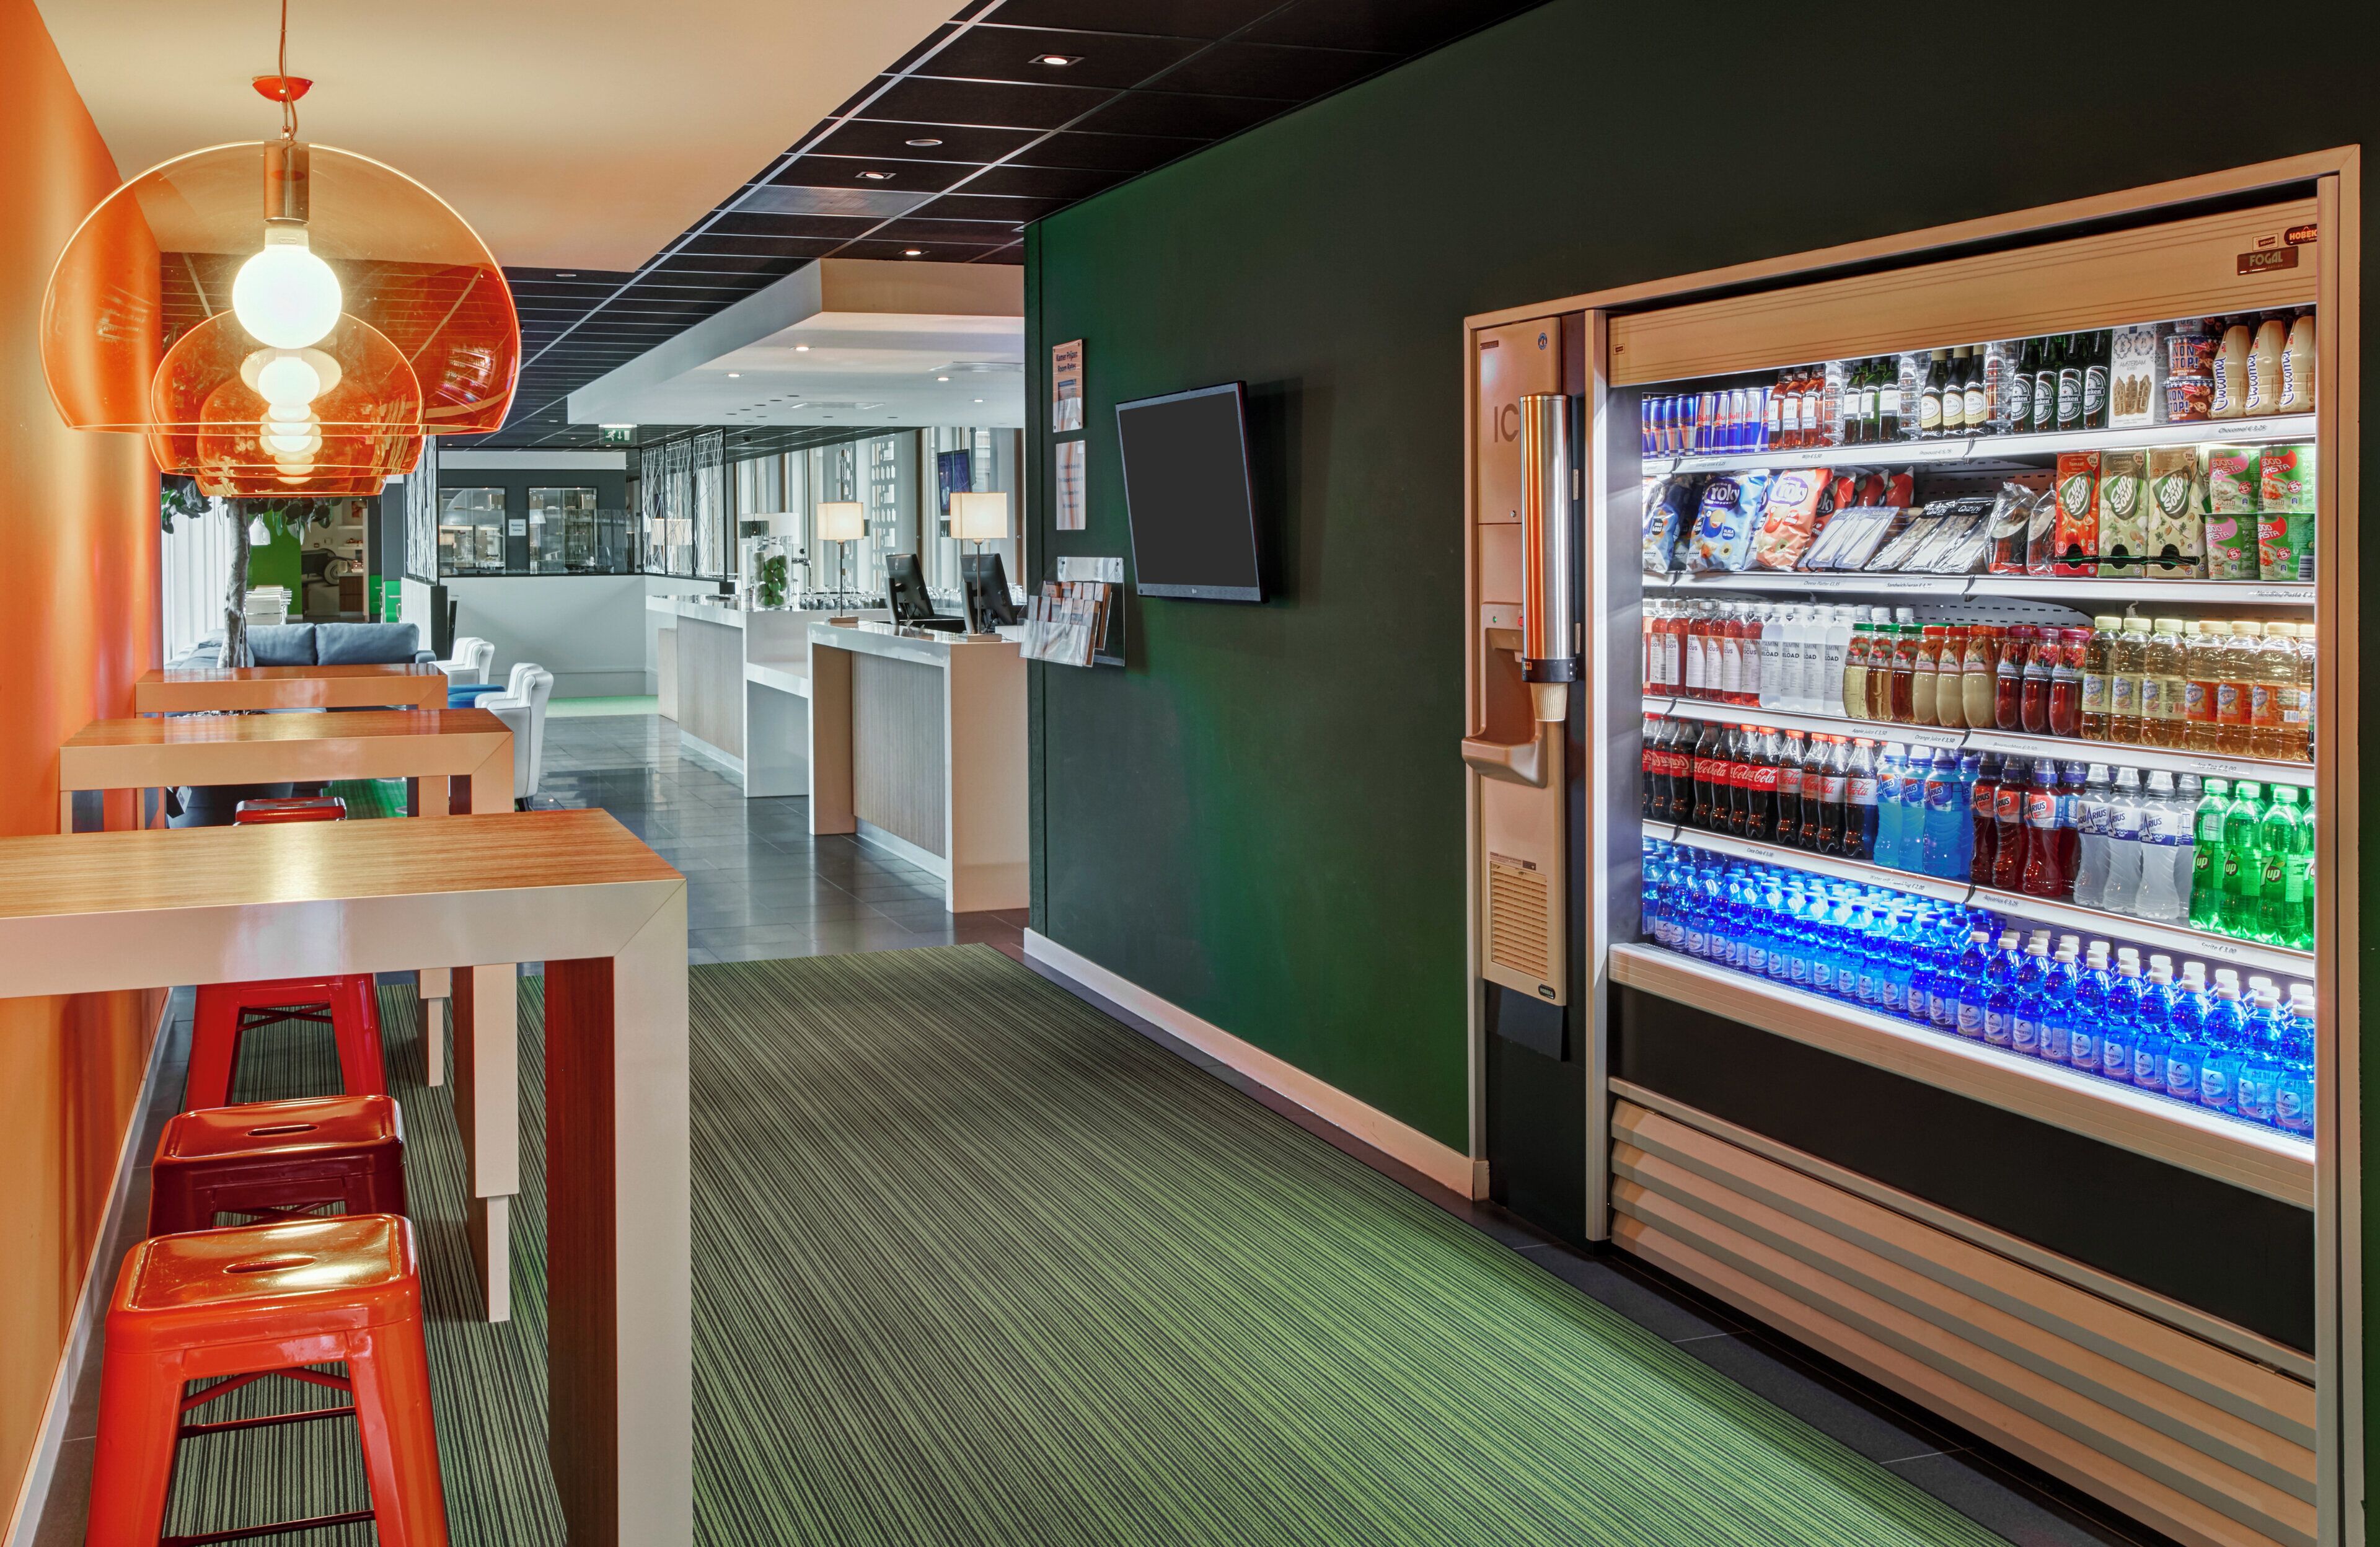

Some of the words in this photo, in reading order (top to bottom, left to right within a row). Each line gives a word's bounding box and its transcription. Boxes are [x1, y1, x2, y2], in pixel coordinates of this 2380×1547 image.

[2289, 229, 2317, 240] HOBEK
[2249, 251, 2283, 267] FOGAL
[2173, 345, 2195, 356] NON
[2172, 358, 2199, 369] STOP!
[2169, 401, 2189, 412] TOP!
[1716, 413, 1725, 421] Bu
[1494, 403, 1519, 443] IC
[2212, 464, 2242, 477] PASTA
